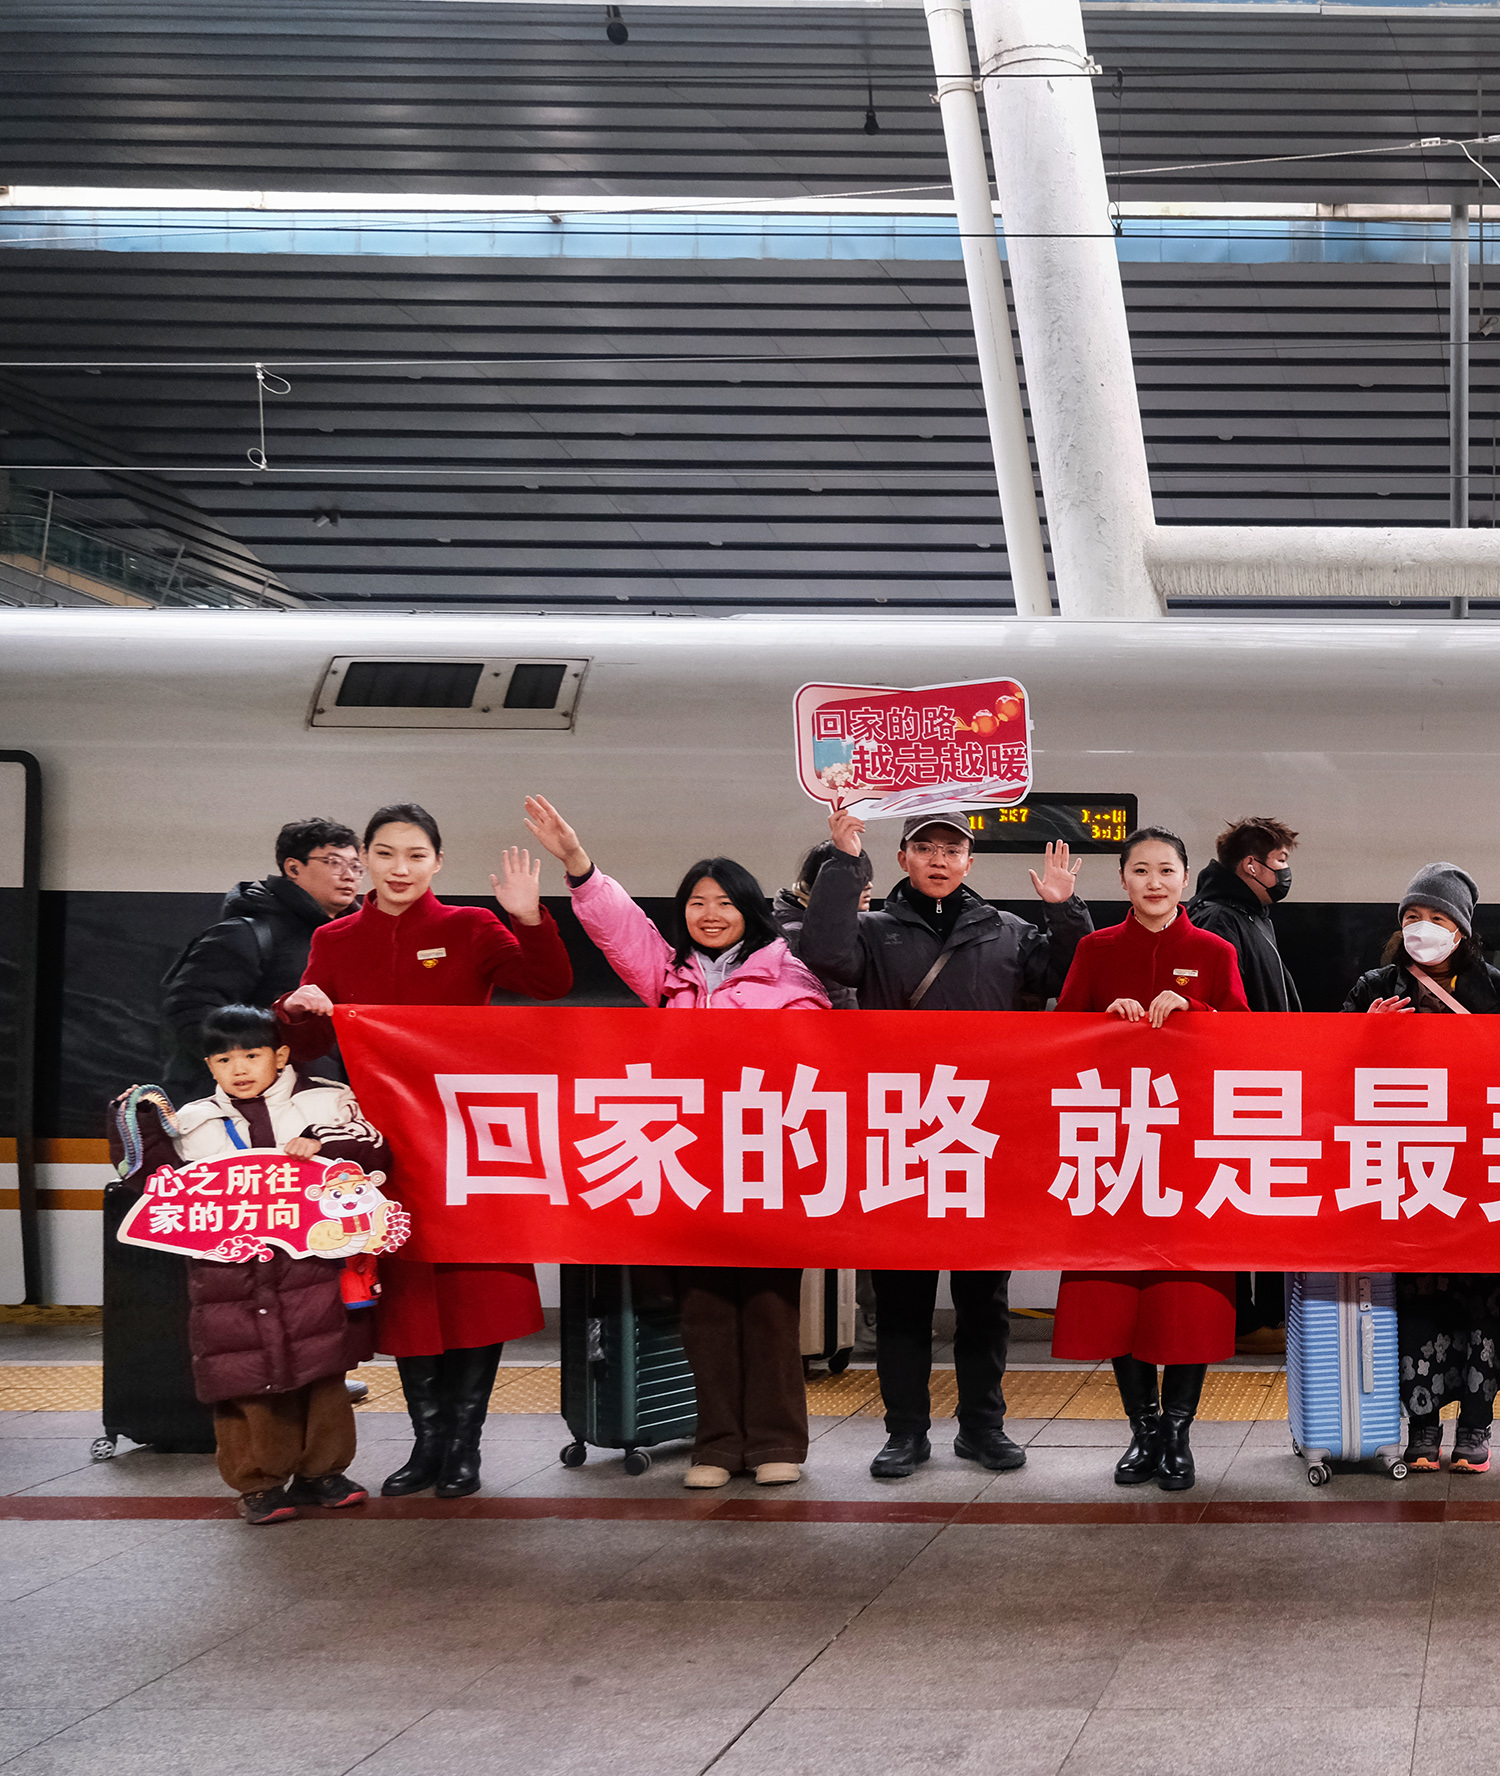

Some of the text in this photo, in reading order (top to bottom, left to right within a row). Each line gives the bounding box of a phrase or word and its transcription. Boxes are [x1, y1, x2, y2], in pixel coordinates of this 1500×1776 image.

[814, 706, 956, 741] 回家的路
[852, 741, 1029, 786] 越走越暖
[434, 1063, 1001, 1218] 回家的路
[147, 1162, 302, 1198] 心之所往
[149, 1199, 300, 1235] 家的方向
